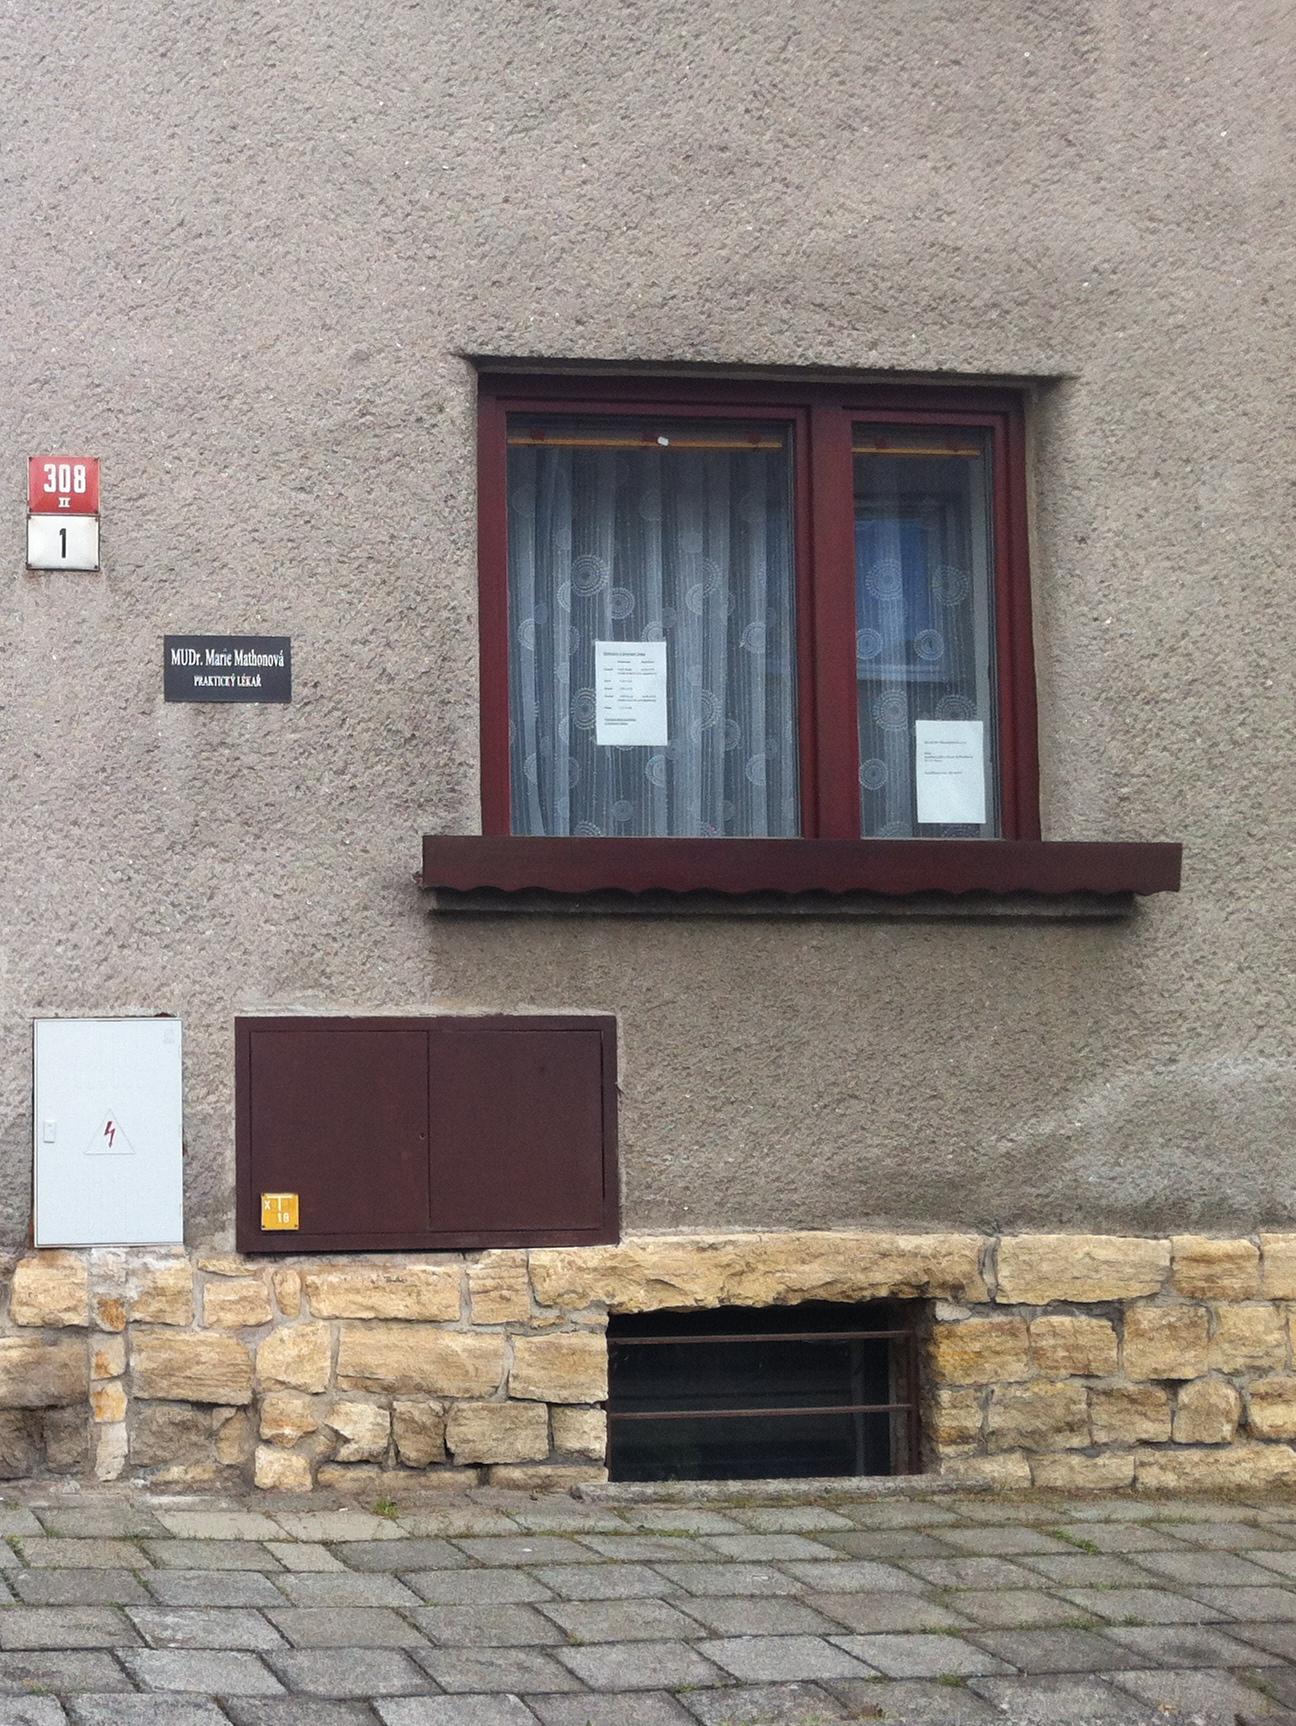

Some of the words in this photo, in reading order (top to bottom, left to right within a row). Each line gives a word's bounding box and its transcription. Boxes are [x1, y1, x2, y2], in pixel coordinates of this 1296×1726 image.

[43, 463, 86, 494] 308
[58, 496, 72, 508] II
[59, 527, 67, 559] 1
[170, 648, 204, 667] MUDr.
[205, 647, 233, 667] Marie
[234, 648, 285, 668] Mathonová
[193, 673, 236, 688] PRAKTICKÝ
[237, 673, 262, 688] LÉKAŘ
